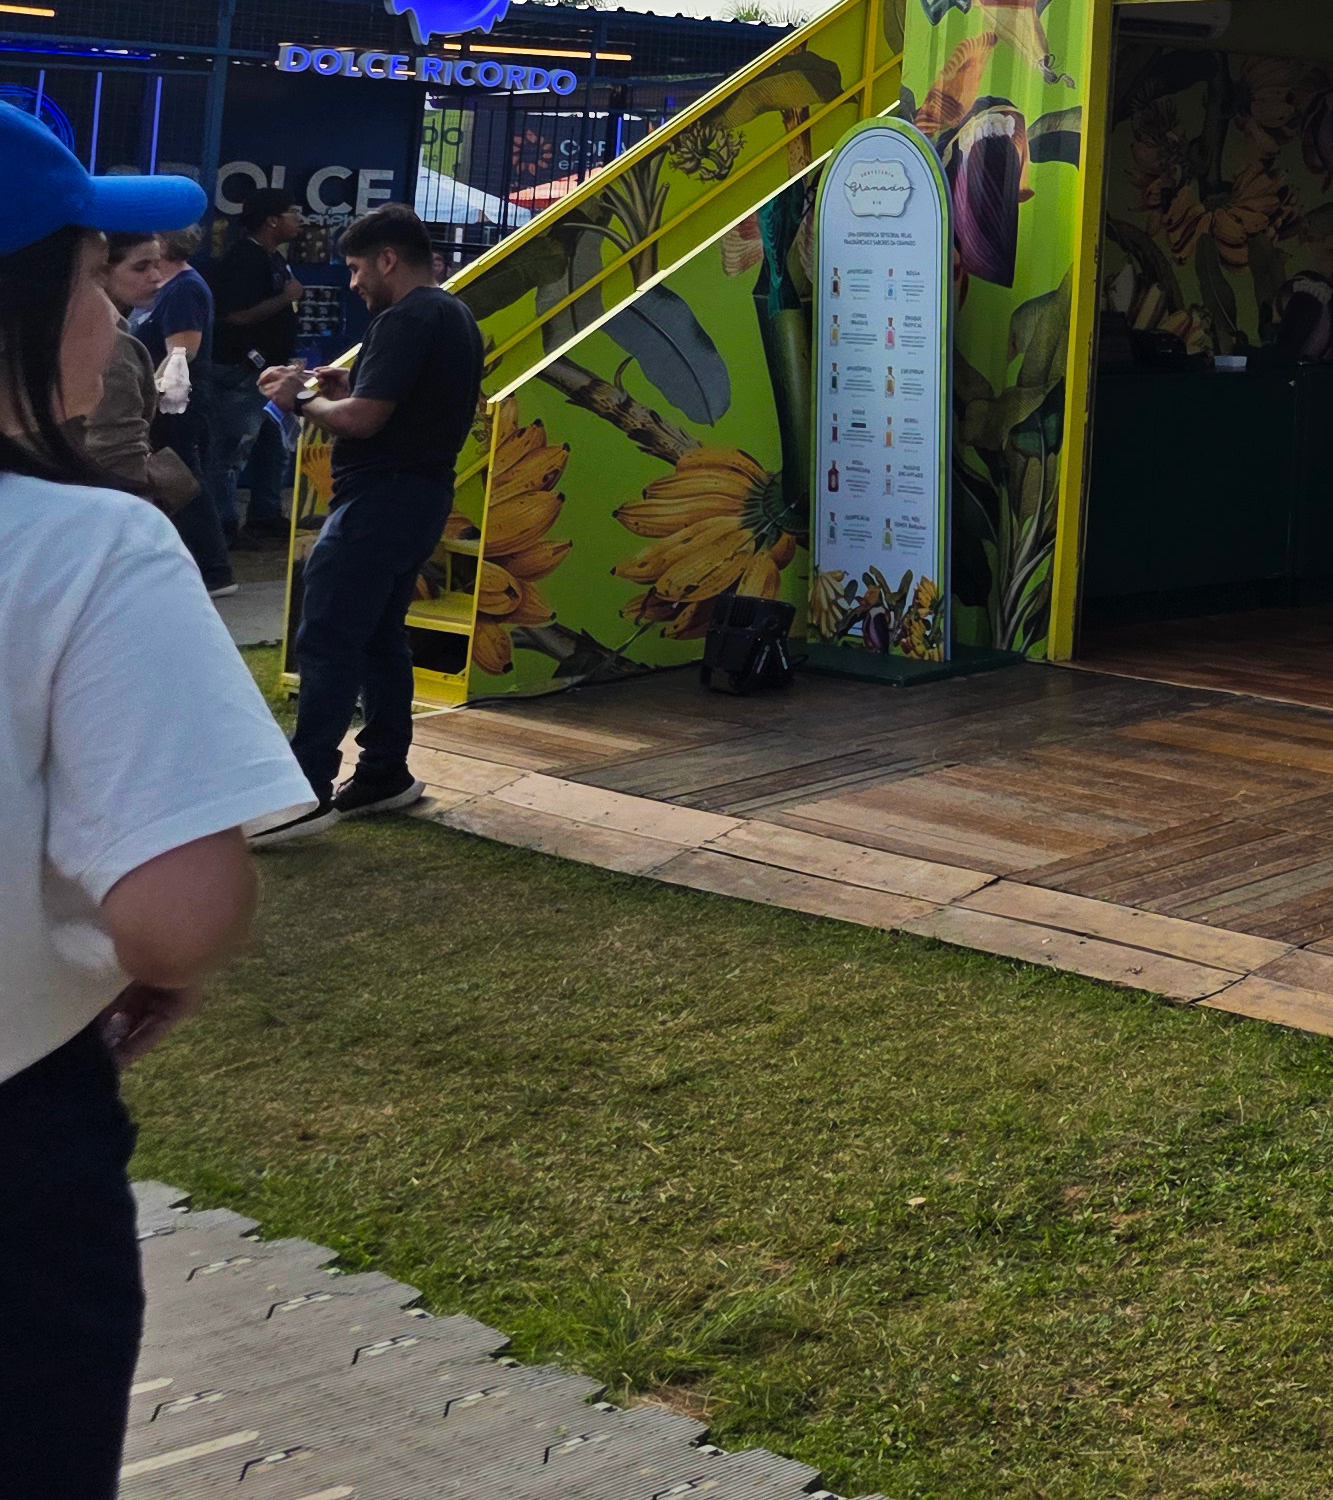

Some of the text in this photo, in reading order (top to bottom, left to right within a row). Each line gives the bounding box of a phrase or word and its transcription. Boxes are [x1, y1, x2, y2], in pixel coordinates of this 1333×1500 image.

[277, 45, 577, 96] DOLCE RICORDO
[844, 181, 916, 197] Granado
